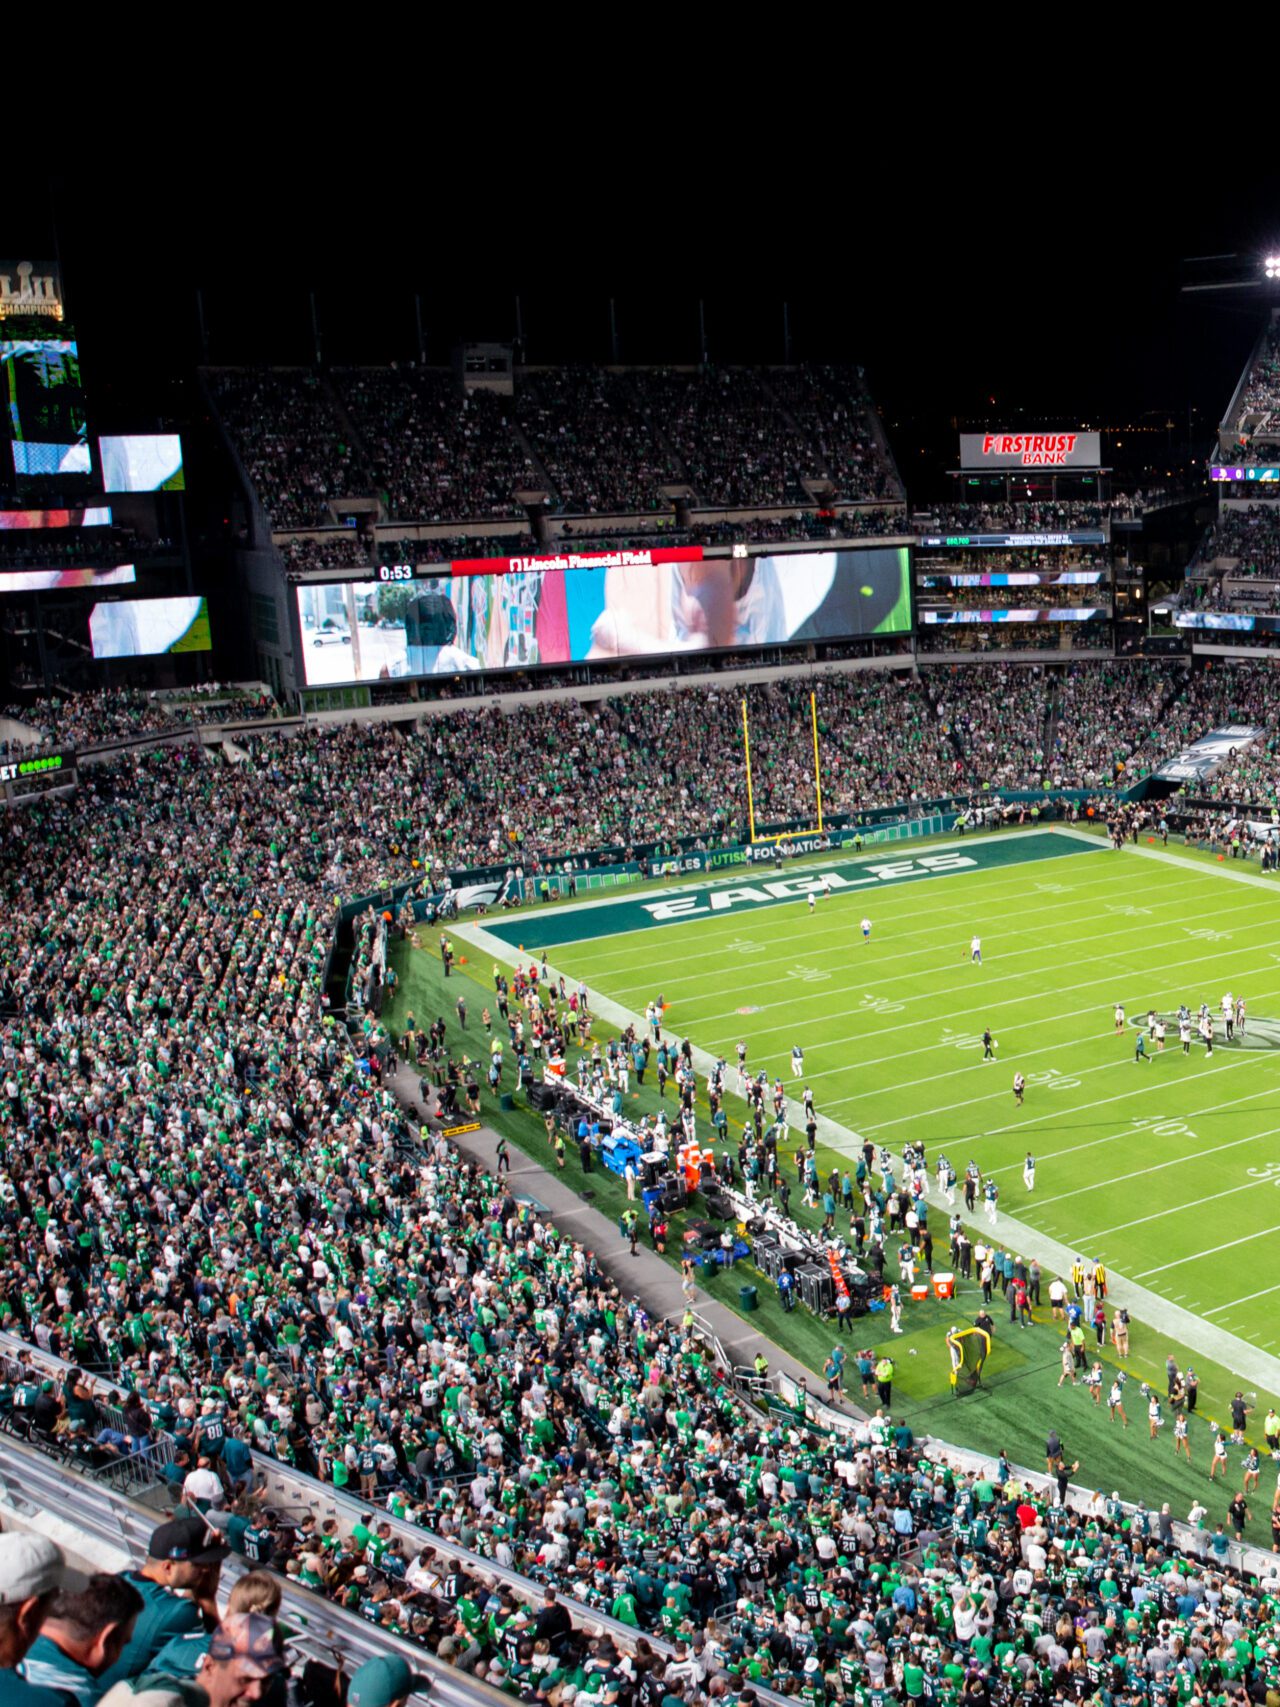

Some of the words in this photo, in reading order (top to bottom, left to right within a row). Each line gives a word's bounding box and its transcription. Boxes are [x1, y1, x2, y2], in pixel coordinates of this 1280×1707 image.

[1022, 452, 1066, 465] BANK
[1235, 469, 1243, 479] 0
[1248, 469, 1255, 479] 0
[522, 556, 568, 572] Lincoln
[568, 553, 621, 568] Financial
[621, 550, 651, 565] Field
[380, 565, 412, 580] 0:53
[0, 764, 18, 780] ET
[641, 852, 978, 921] EAGLES
[1026, 1068, 1082, 1090] 50
[505, 1643, 518, 1662] 11
